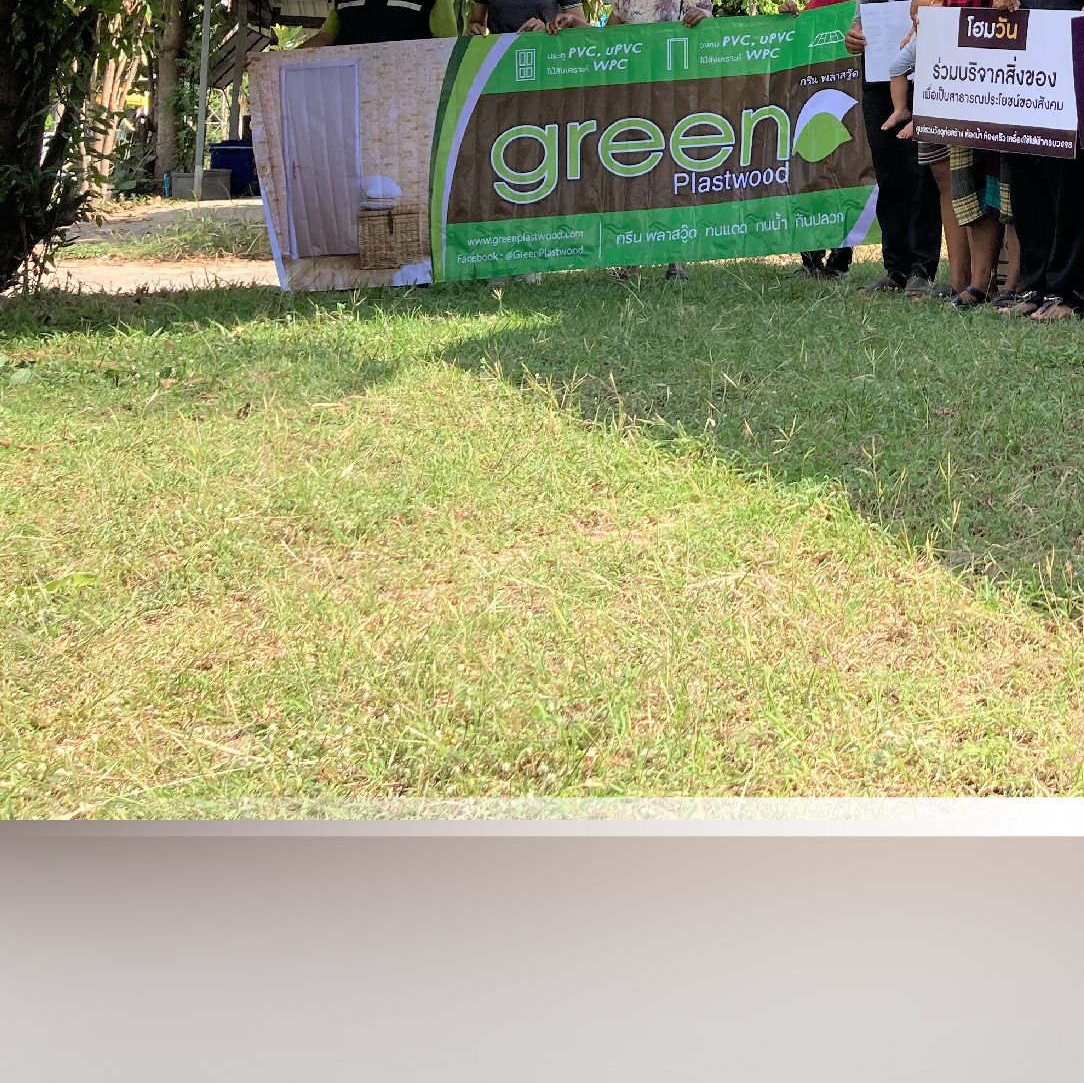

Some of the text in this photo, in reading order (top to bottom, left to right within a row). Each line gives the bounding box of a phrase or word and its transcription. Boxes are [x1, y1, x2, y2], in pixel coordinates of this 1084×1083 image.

[967, 15, 1019, 40] โฮมวัน
[722, 34, 756, 48] PVC,
[759, 30, 796, 45] uPVC
[568, 45, 601, 59] PVC,
[605, 42, 644, 56] uPVC
[745, 48, 781, 61] WPC
[593, 58, 629, 72] WPC
[932, 55, 1057, 88] ร่วมบริจาคสิ่งของ
[922, 83, 1064, 111] เพื่อเป็นสาธารณประโยชน์ของสังคม
[490, 104, 792, 206] green
[673, 159, 791, 196] Plastwood
[467, 229, 584, 247] www.greenplastwood.com
[616, 229, 642, 245] กรีน
[705, 222, 747, 238] ทนแดด
[755, 211, 788, 232] ทนน้ำ
[795, 212, 845, 229] กันปลวก
[457, 251, 499, 264] Facebook
